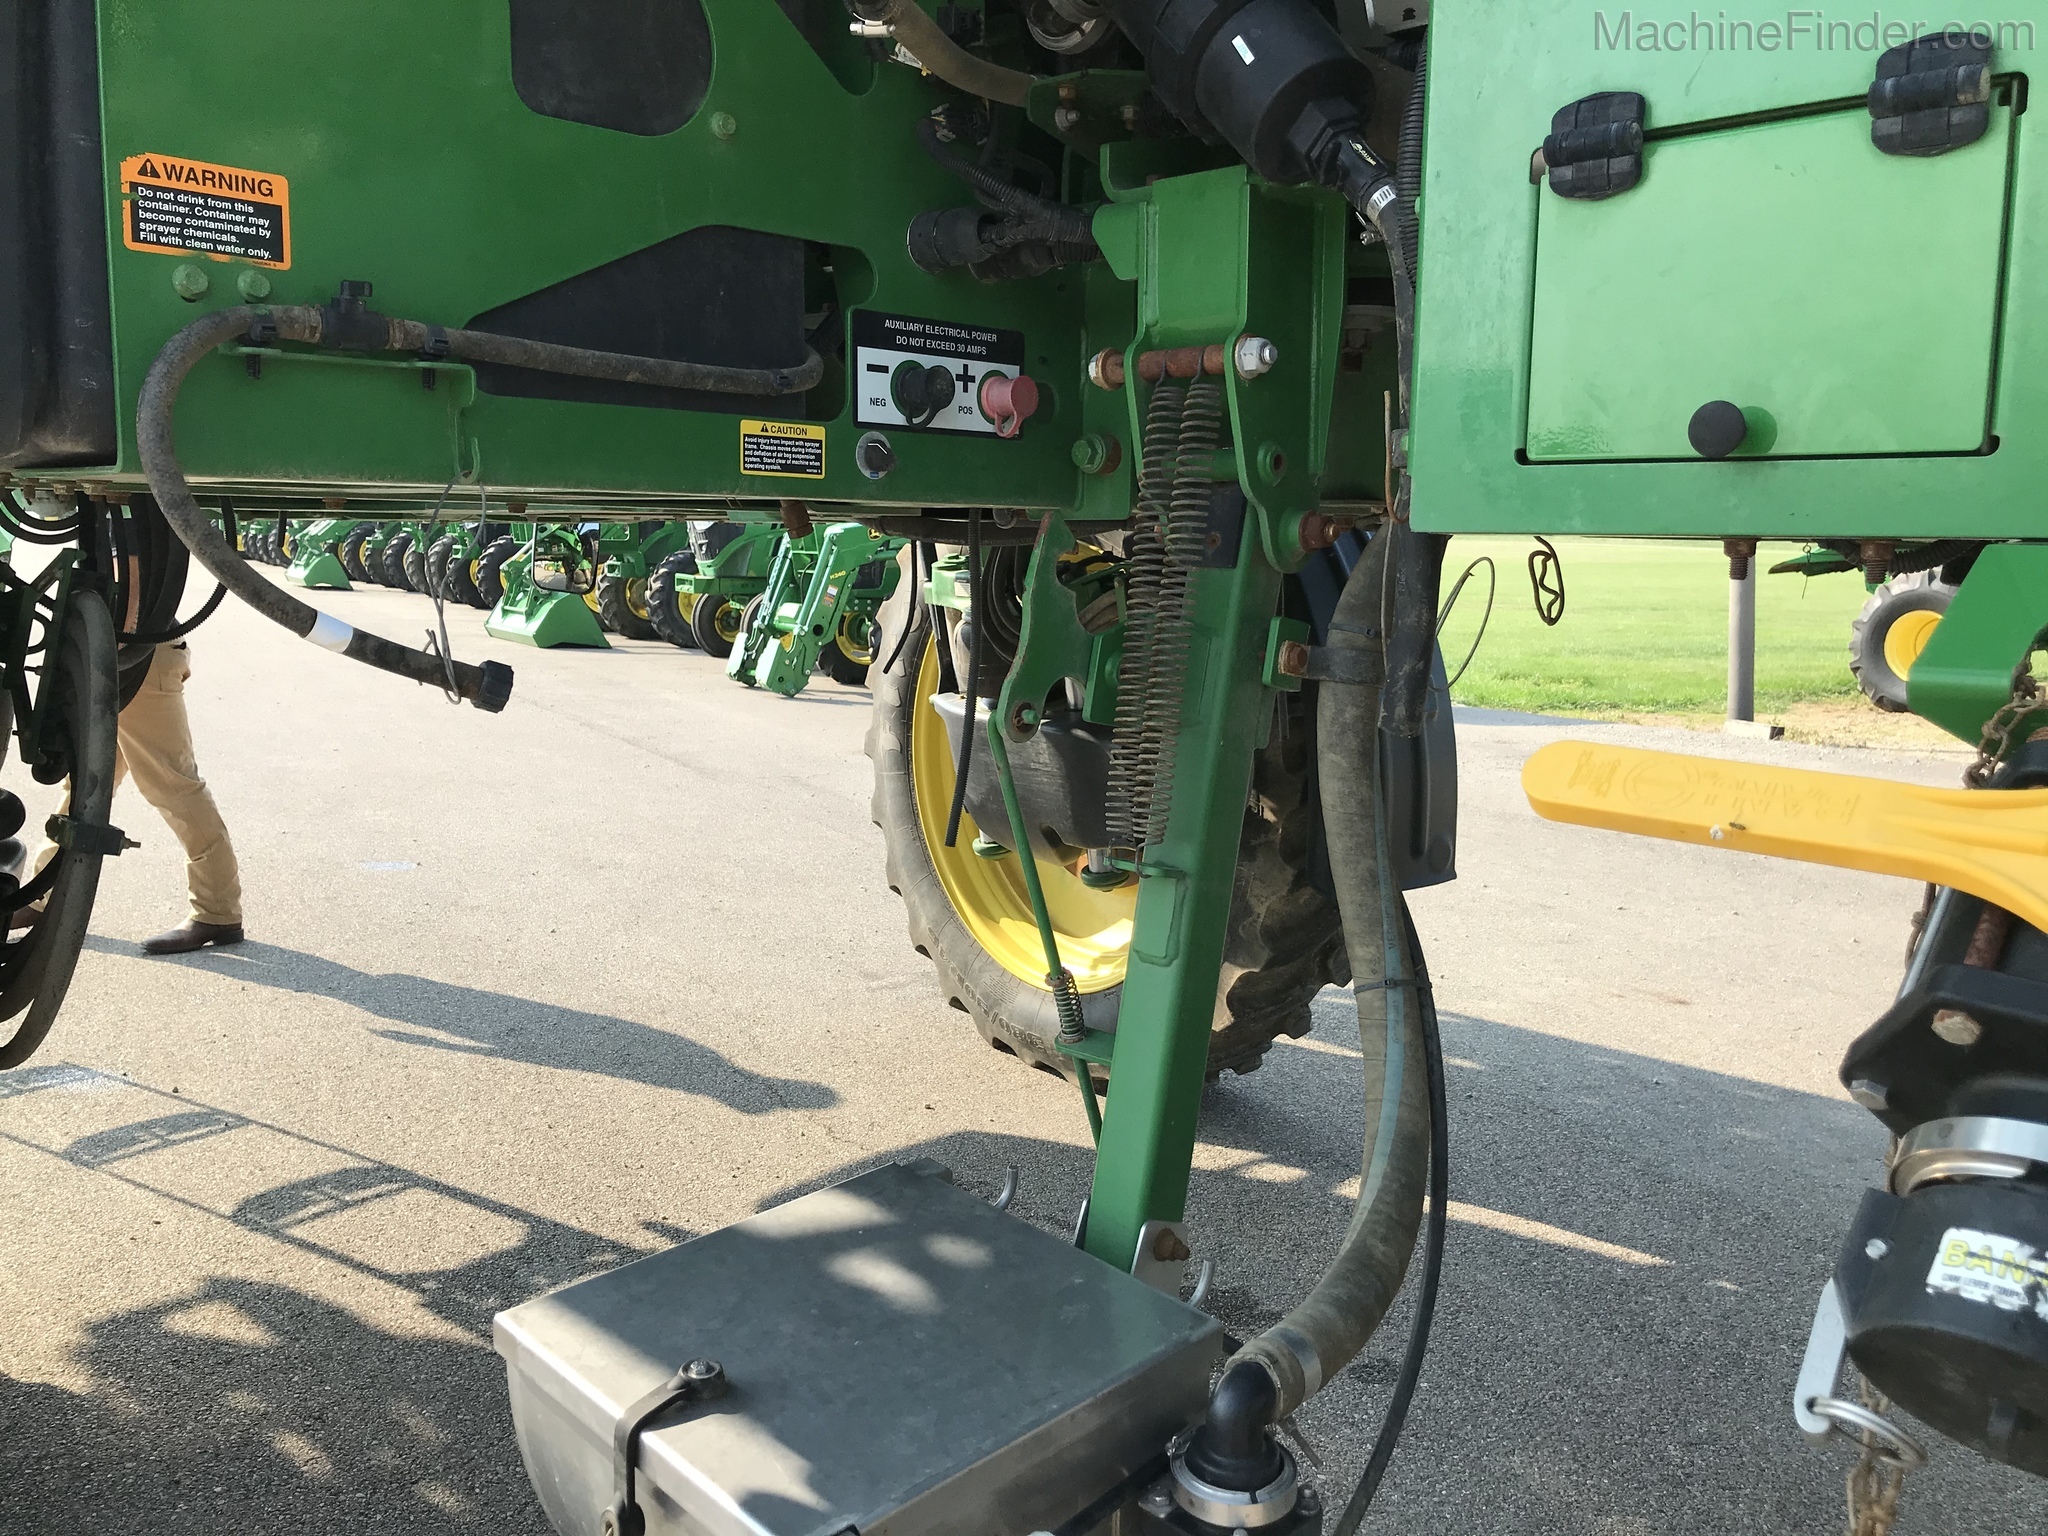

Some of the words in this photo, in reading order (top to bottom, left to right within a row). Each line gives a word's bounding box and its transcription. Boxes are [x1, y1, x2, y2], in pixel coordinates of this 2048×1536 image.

[162, 162, 274, 198] WARNING
[137, 187, 154, 197] Do
[156, 190, 174, 201] not
[177, 194, 204, 205] drink
[207, 199, 232, 210] from
[235, 202, 254, 213] this
[138, 200, 192, 215] container.
[195, 207, 246, 222] Container
[248, 216, 269, 228] may
[139, 209, 182, 223] become
[185, 217, 256, 235] contaminated
[259, 228, 271, 238] by
[139, 222, 180, 235] sprayer
[183, 227, 239, 243] chemicals.
[140, 232, 156, 242] Fill
[160, 235, 182, 245] with
[185, 239, 213, 250] clean
[217, 243, 245, 254] water
[248, 248, 271, 259] only.
[884, 319, 923, 332] AUXILIARY
[925, 325, 970, 339] ELECTRICAL
[972, 332, 997, 342] POWER
[896, 335, 908, 345] DO
[909, 337, 925, 347] NOT
[926, 340, 955, 350] EXCEED
[957, 344, 965, 352] 30
[966, 345, 986, 355] AMPS
[870, 398, 886, 407] NEG
[958, 406, 973, 414] POS
[771, 425, 807, 436] CAUTION
